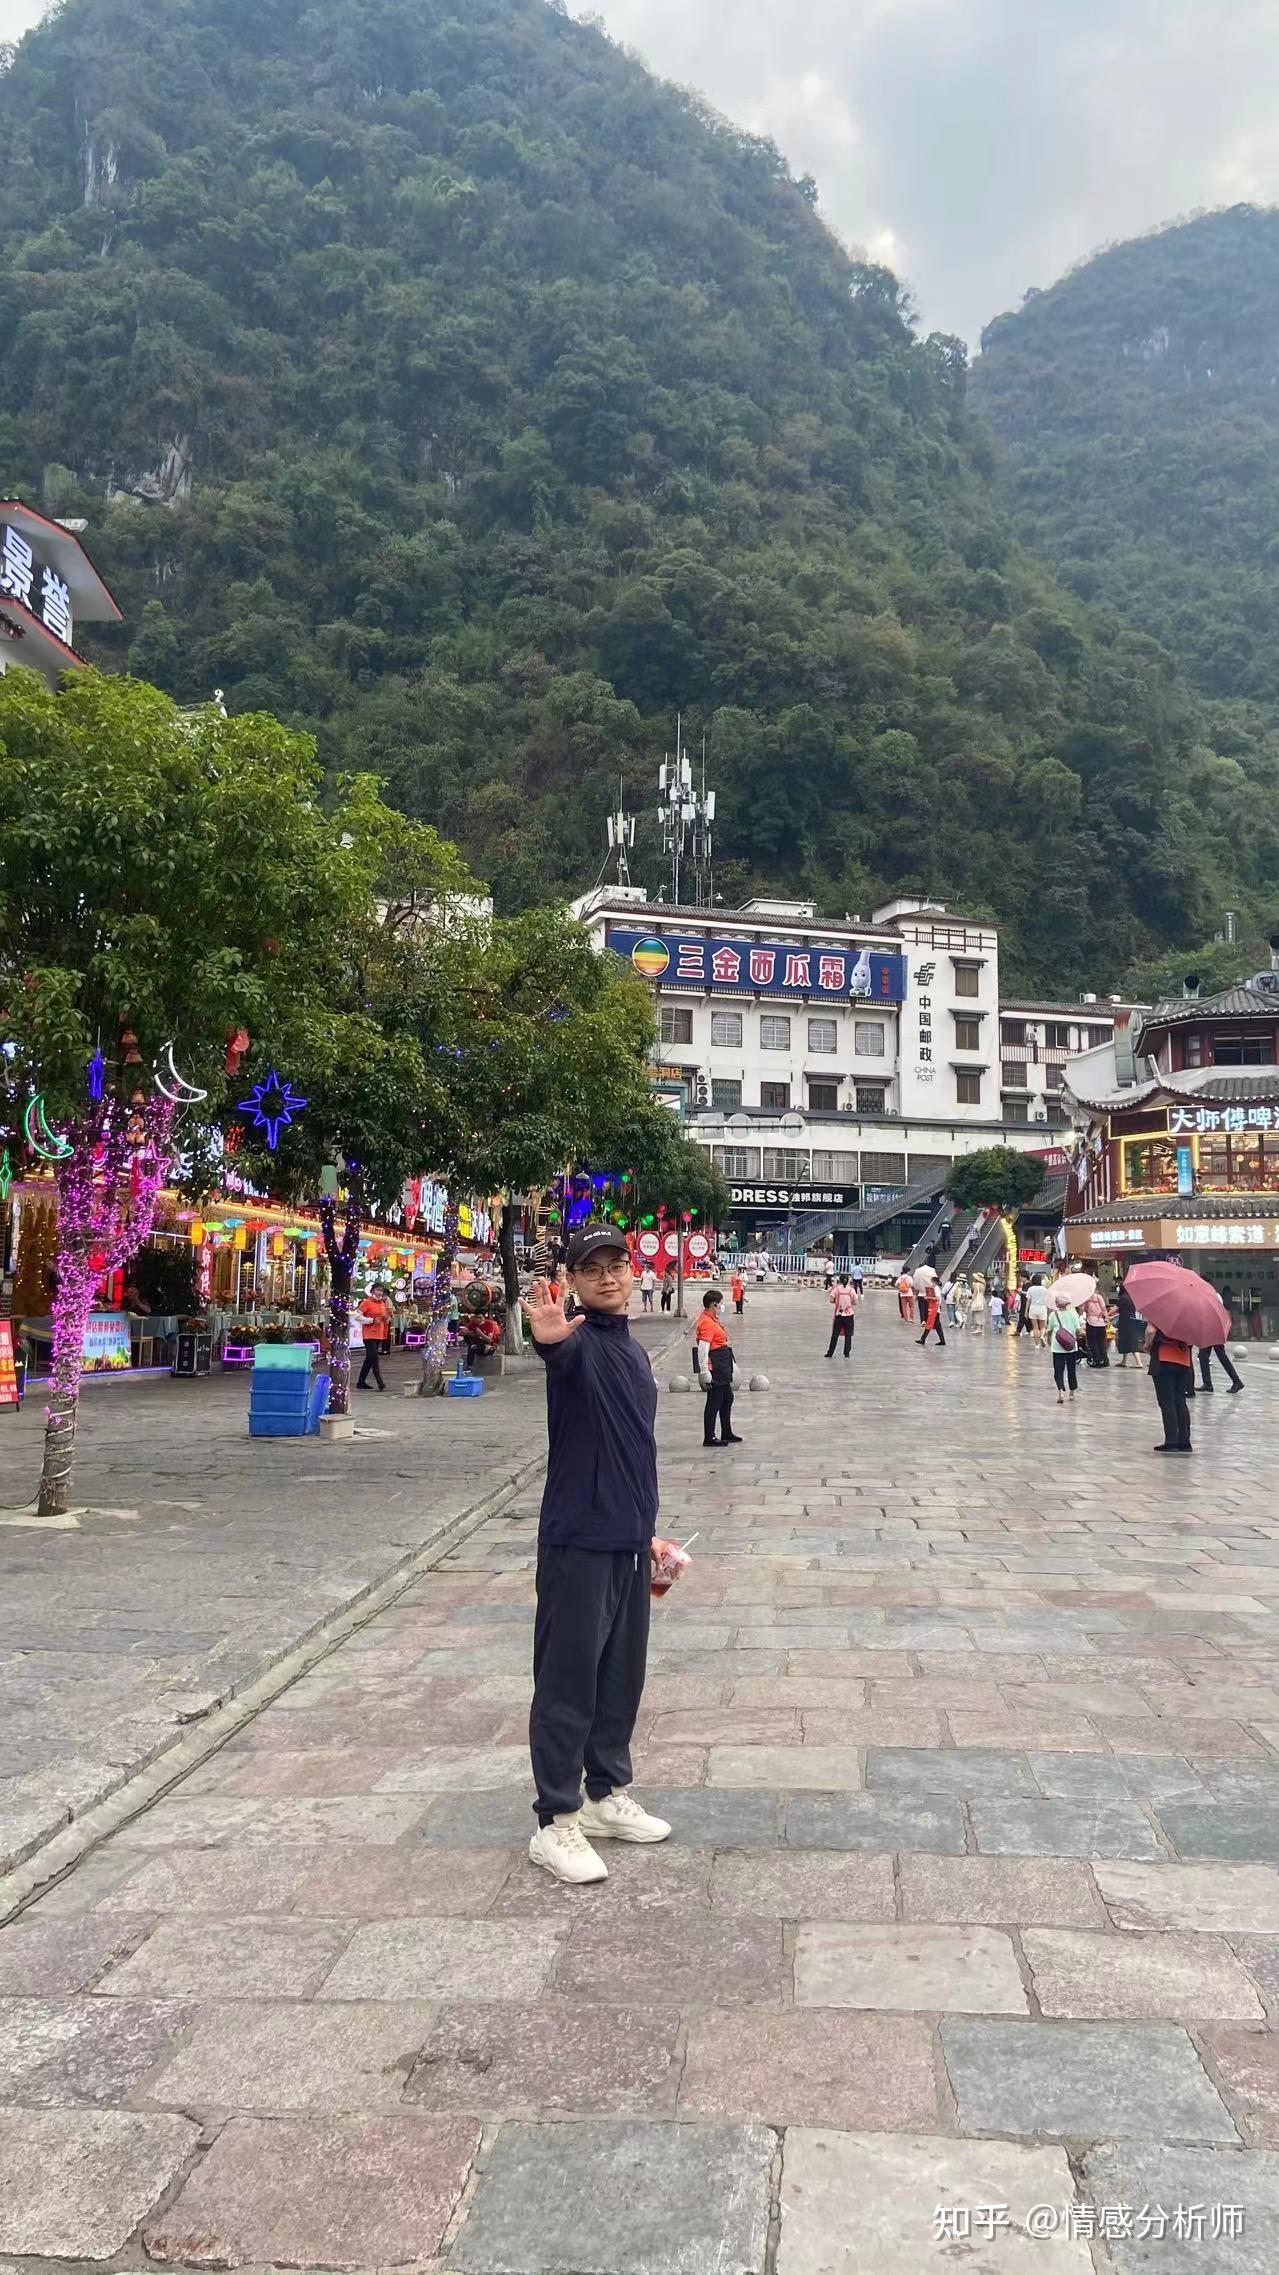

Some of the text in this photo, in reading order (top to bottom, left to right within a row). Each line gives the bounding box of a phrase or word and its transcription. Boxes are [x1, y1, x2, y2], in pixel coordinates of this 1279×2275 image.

[677, 944, 846, 990] 三金西瓜霜
[919, 995, 932, 1062] 中国邮政
[914, 1066, 936, 1074] CHINA
[917, 1074, 934, 1082] POST
[1176, 1225, 1279, 1244] 如意峰索道·
